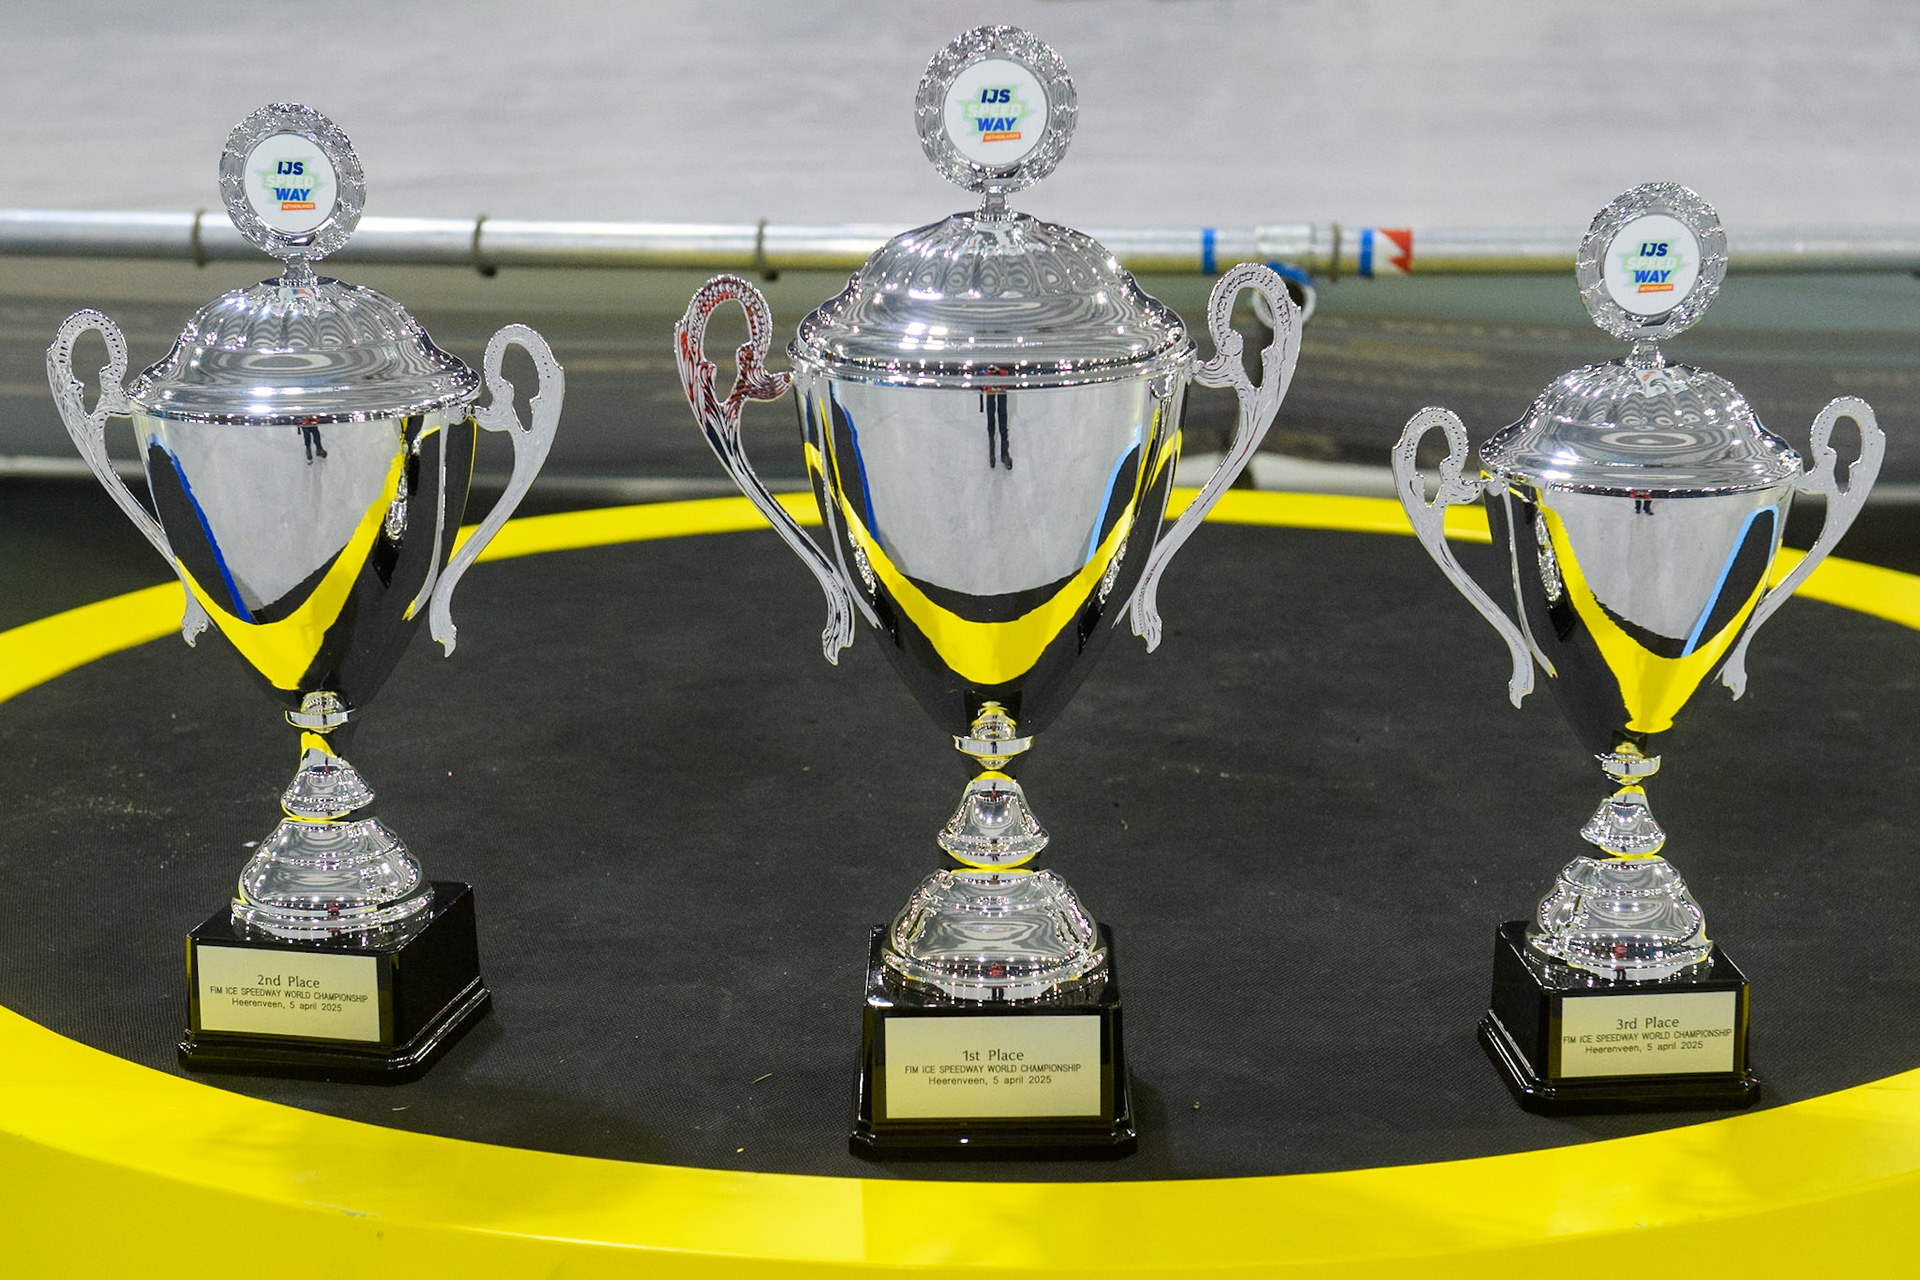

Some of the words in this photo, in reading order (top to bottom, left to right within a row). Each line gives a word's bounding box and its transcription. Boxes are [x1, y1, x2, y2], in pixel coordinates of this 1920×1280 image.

[981, 89, 1011, 104] IJS
[967, 103, 1022, 118] SPEED
[975, 117, 1017, 131] WAY
[277, 161, 304, 175] IJS
[265, 175, 315, 188] SPEED
[272, 187, 311, 201] WAY
[1640, 243, 1668, 257] IJS
[1625, 257, 1677, 269] SPEED
[1632, 270, 1671, 283] WAY
[257, 974, 281, 986] 2nd
[288, 976, 320, 988] Place
[210, 986, 223, 995] FIM
[226, 987, 238, 995] ICE
[241, 988, 281, 998] SPEEDWAY
[284, 990, 311, 999] WORLD
[314, 991, 368, 1003] CHAMPIONSHIP
[232, 998, 285, 1009] Heerenveen,
[289, 1001, 295, 1009] 5
[300, 1002, 317, 1011] april
[321, 1003, 342, 1012] 2025
[1616, 1018, 1637, 1030] 3rd
[1645, 1016, 1680, 1029] Place
[1563, 1036, 1576, 1044] FIM
[1580, 1035, 1592, 1043] ICE
[1595, 1033, 1639, 1043] SPEEDWAY
[1642, 1031, 1671, 1041] WORLD
[1673, 1028, 1732, 1039] CHAMPIONSHIP
[1585, 1045, 1642, 1055] Heerenveen,
[1647, 1043, 1653, 1051] 5
[1657, 1042, 1677, 1051] april
[1681, 1041, 1703, 1050] 2025
[962, 1050, 981, 1062] 1st
[988, 1049, 1025, 1061] Place
[905, 1066, 919, 1074] FIM
[922, 1065, 936, 1074] ICE
[939, 1065, 984, 1073] SPEEDWAY
[988, 1064, 1017, 1073] WORLD
[1020, 1064, 1082, 1073] CHAMPIONSHIP
[928, 1076, 988, 1086] Heerenveen,
[993, 1076, 999, 1085] 5
[1004, 1075, 1024, 1086] april
[1028, 1075, 1052, 1084] 2025
